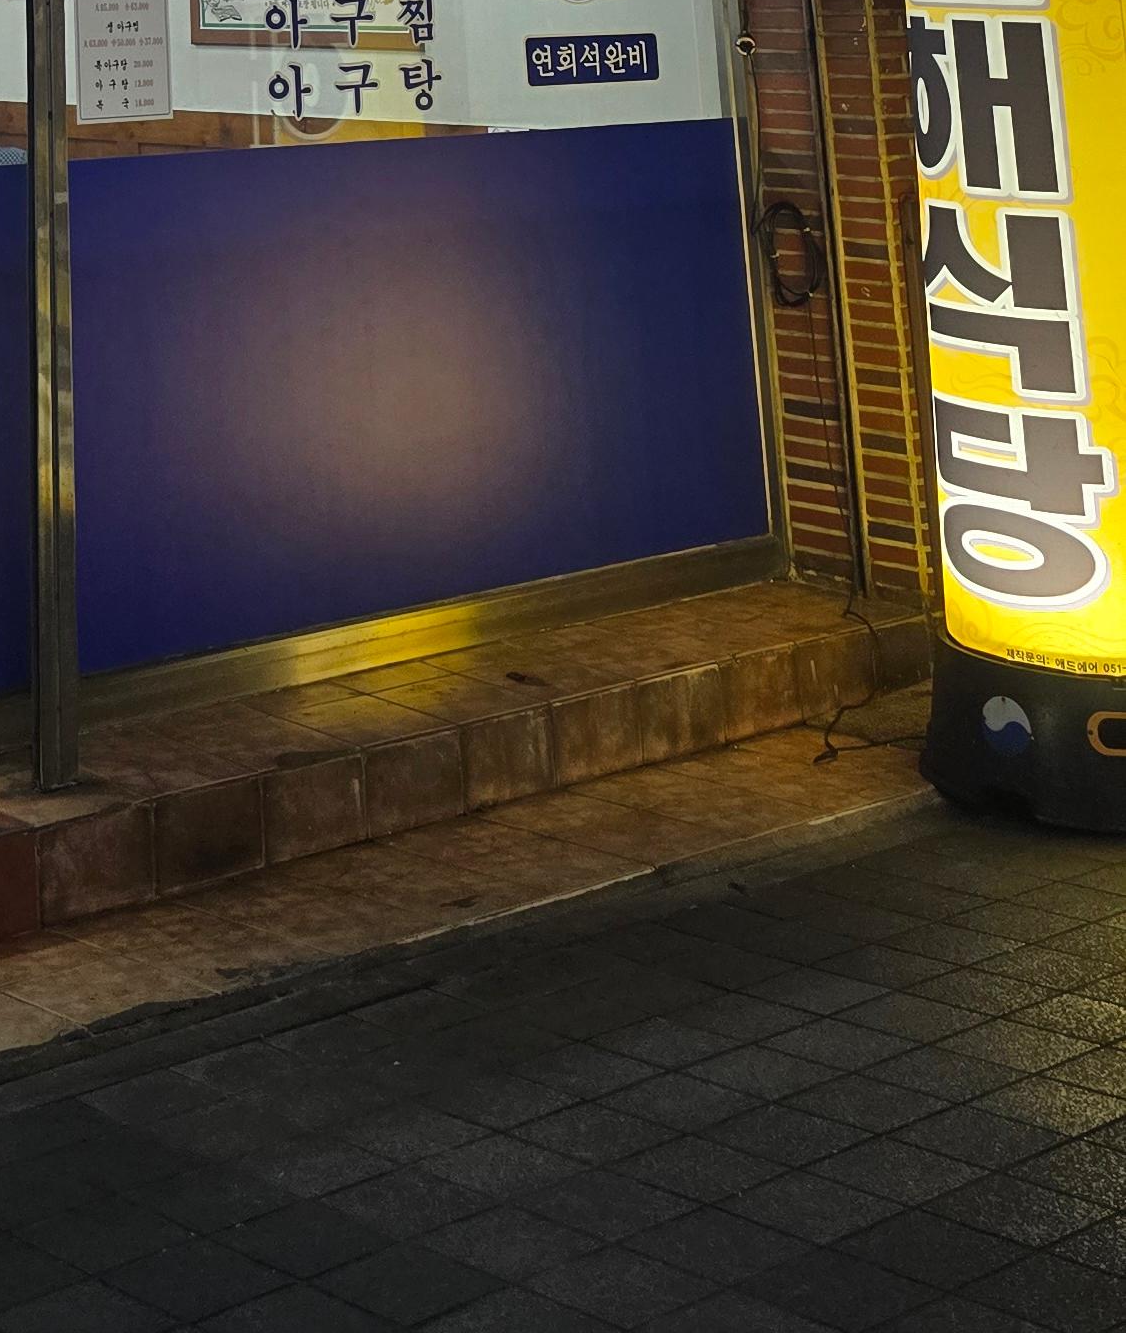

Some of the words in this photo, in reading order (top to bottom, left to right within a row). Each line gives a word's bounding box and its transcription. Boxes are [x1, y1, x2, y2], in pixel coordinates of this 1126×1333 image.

[530, 39, 650, 80] 연회석완비
[268, 59, 443, 120] 아구탕
[1055, 657, 1098, 674] 애드에어
